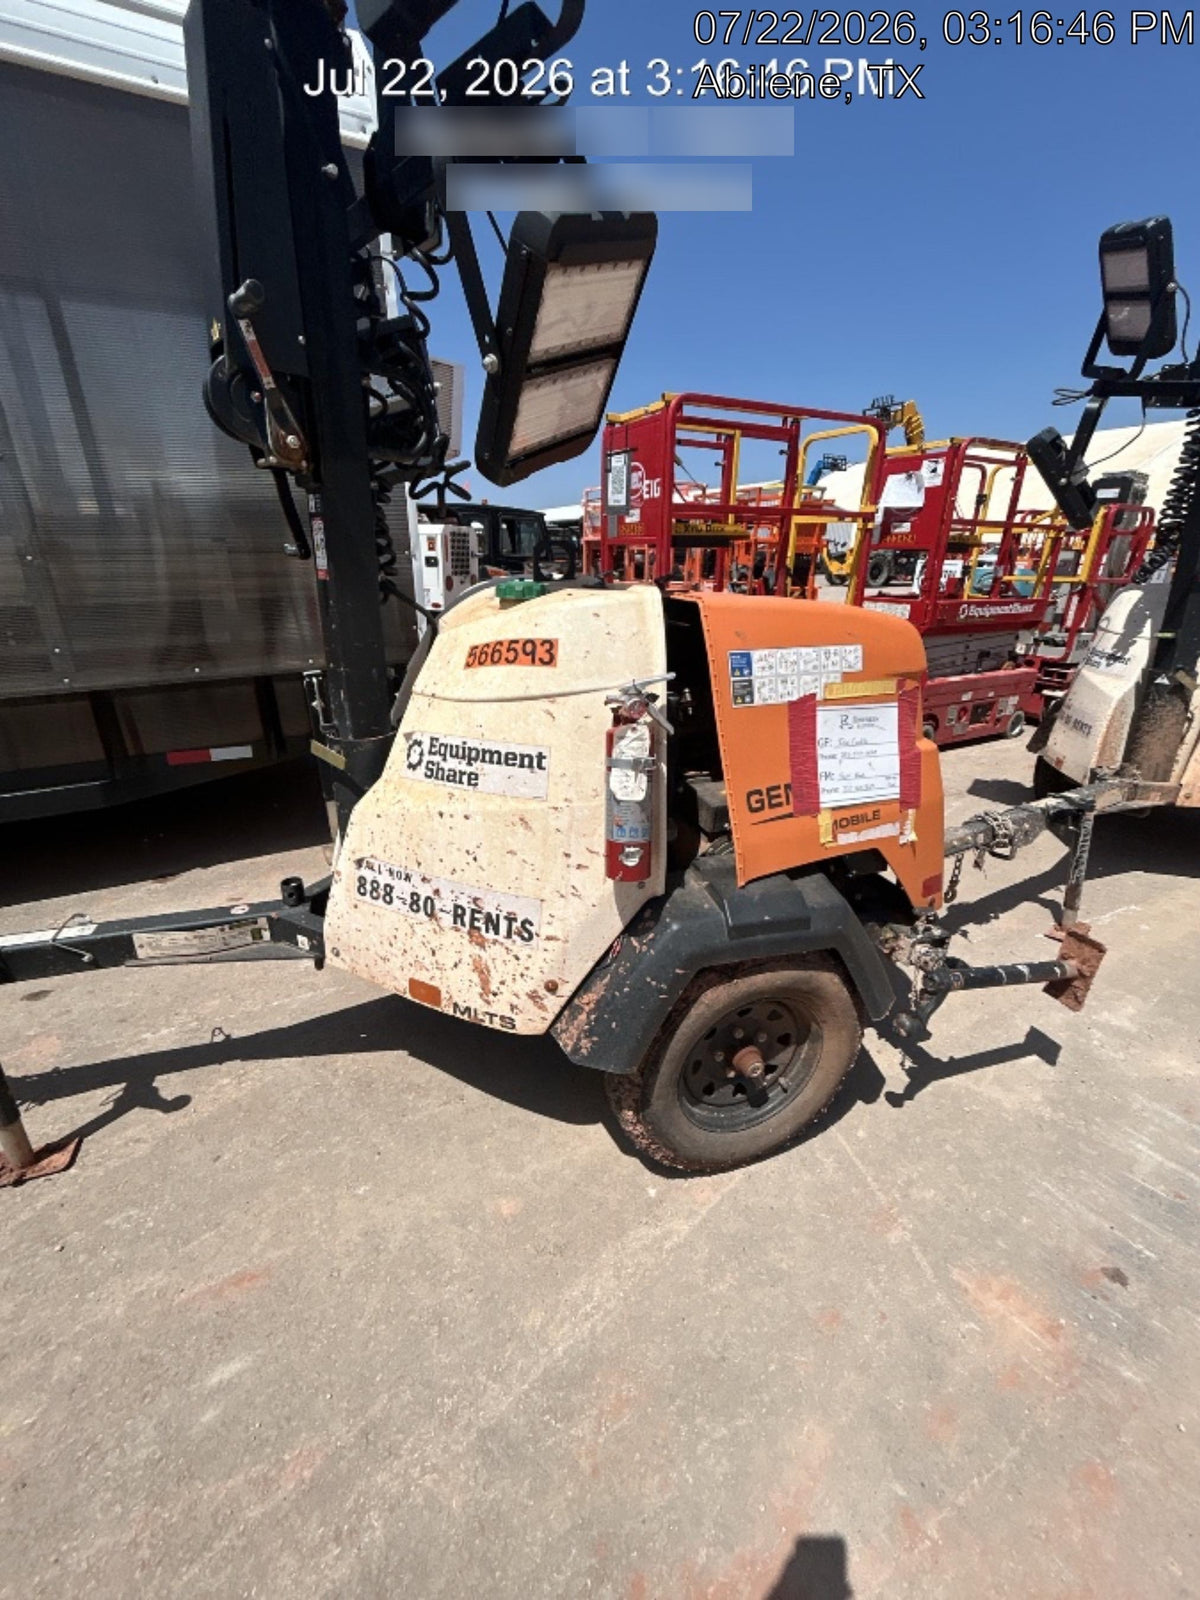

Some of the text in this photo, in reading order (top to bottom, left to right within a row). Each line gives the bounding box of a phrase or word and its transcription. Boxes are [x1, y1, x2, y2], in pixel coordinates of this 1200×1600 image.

[466, 639, 556, 668] 566593
[428, 736, 547, 770] Equipment
[424, 760, 479, 787] Share
[453, 1002, 516, 1029] MLTS
